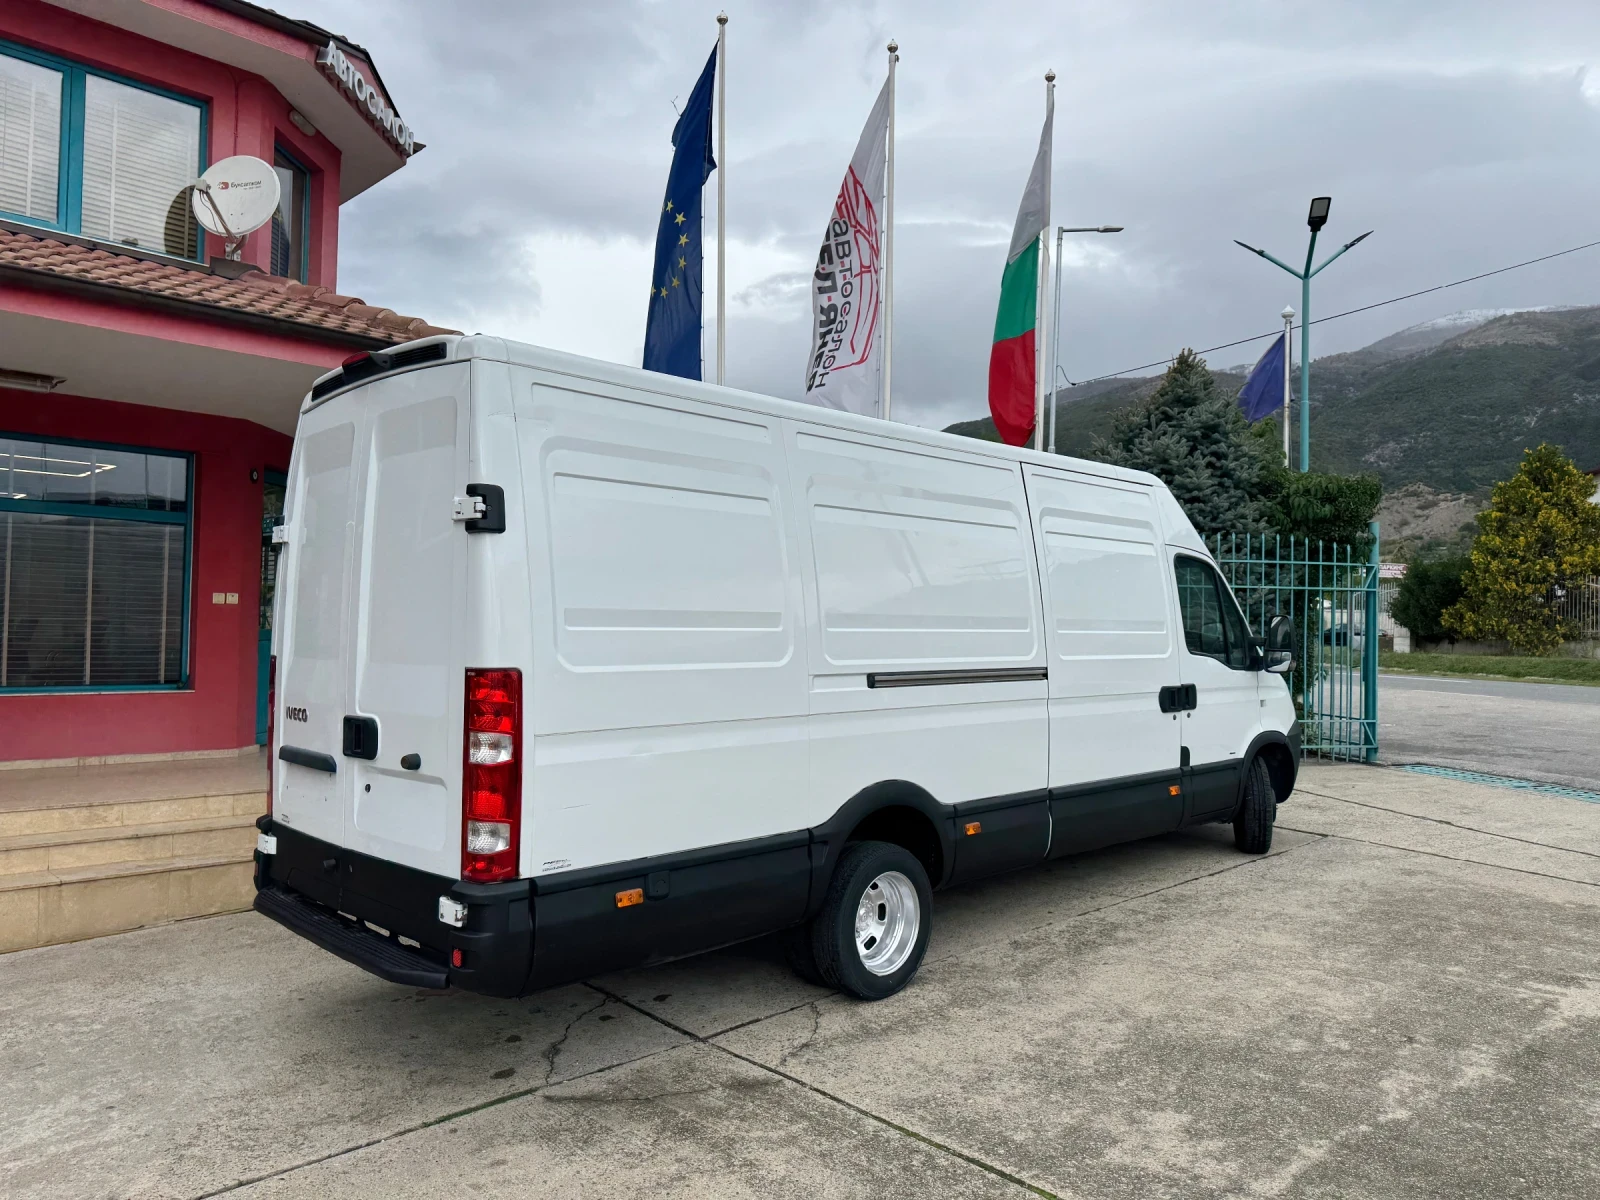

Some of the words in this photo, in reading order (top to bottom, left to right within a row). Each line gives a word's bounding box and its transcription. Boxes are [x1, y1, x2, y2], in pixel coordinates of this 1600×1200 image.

[323, 40, 415, 155] АВТОСАЛОН
[814, 219, 854, 389] автосалон
[285, 705, 308, 723] IVECO
